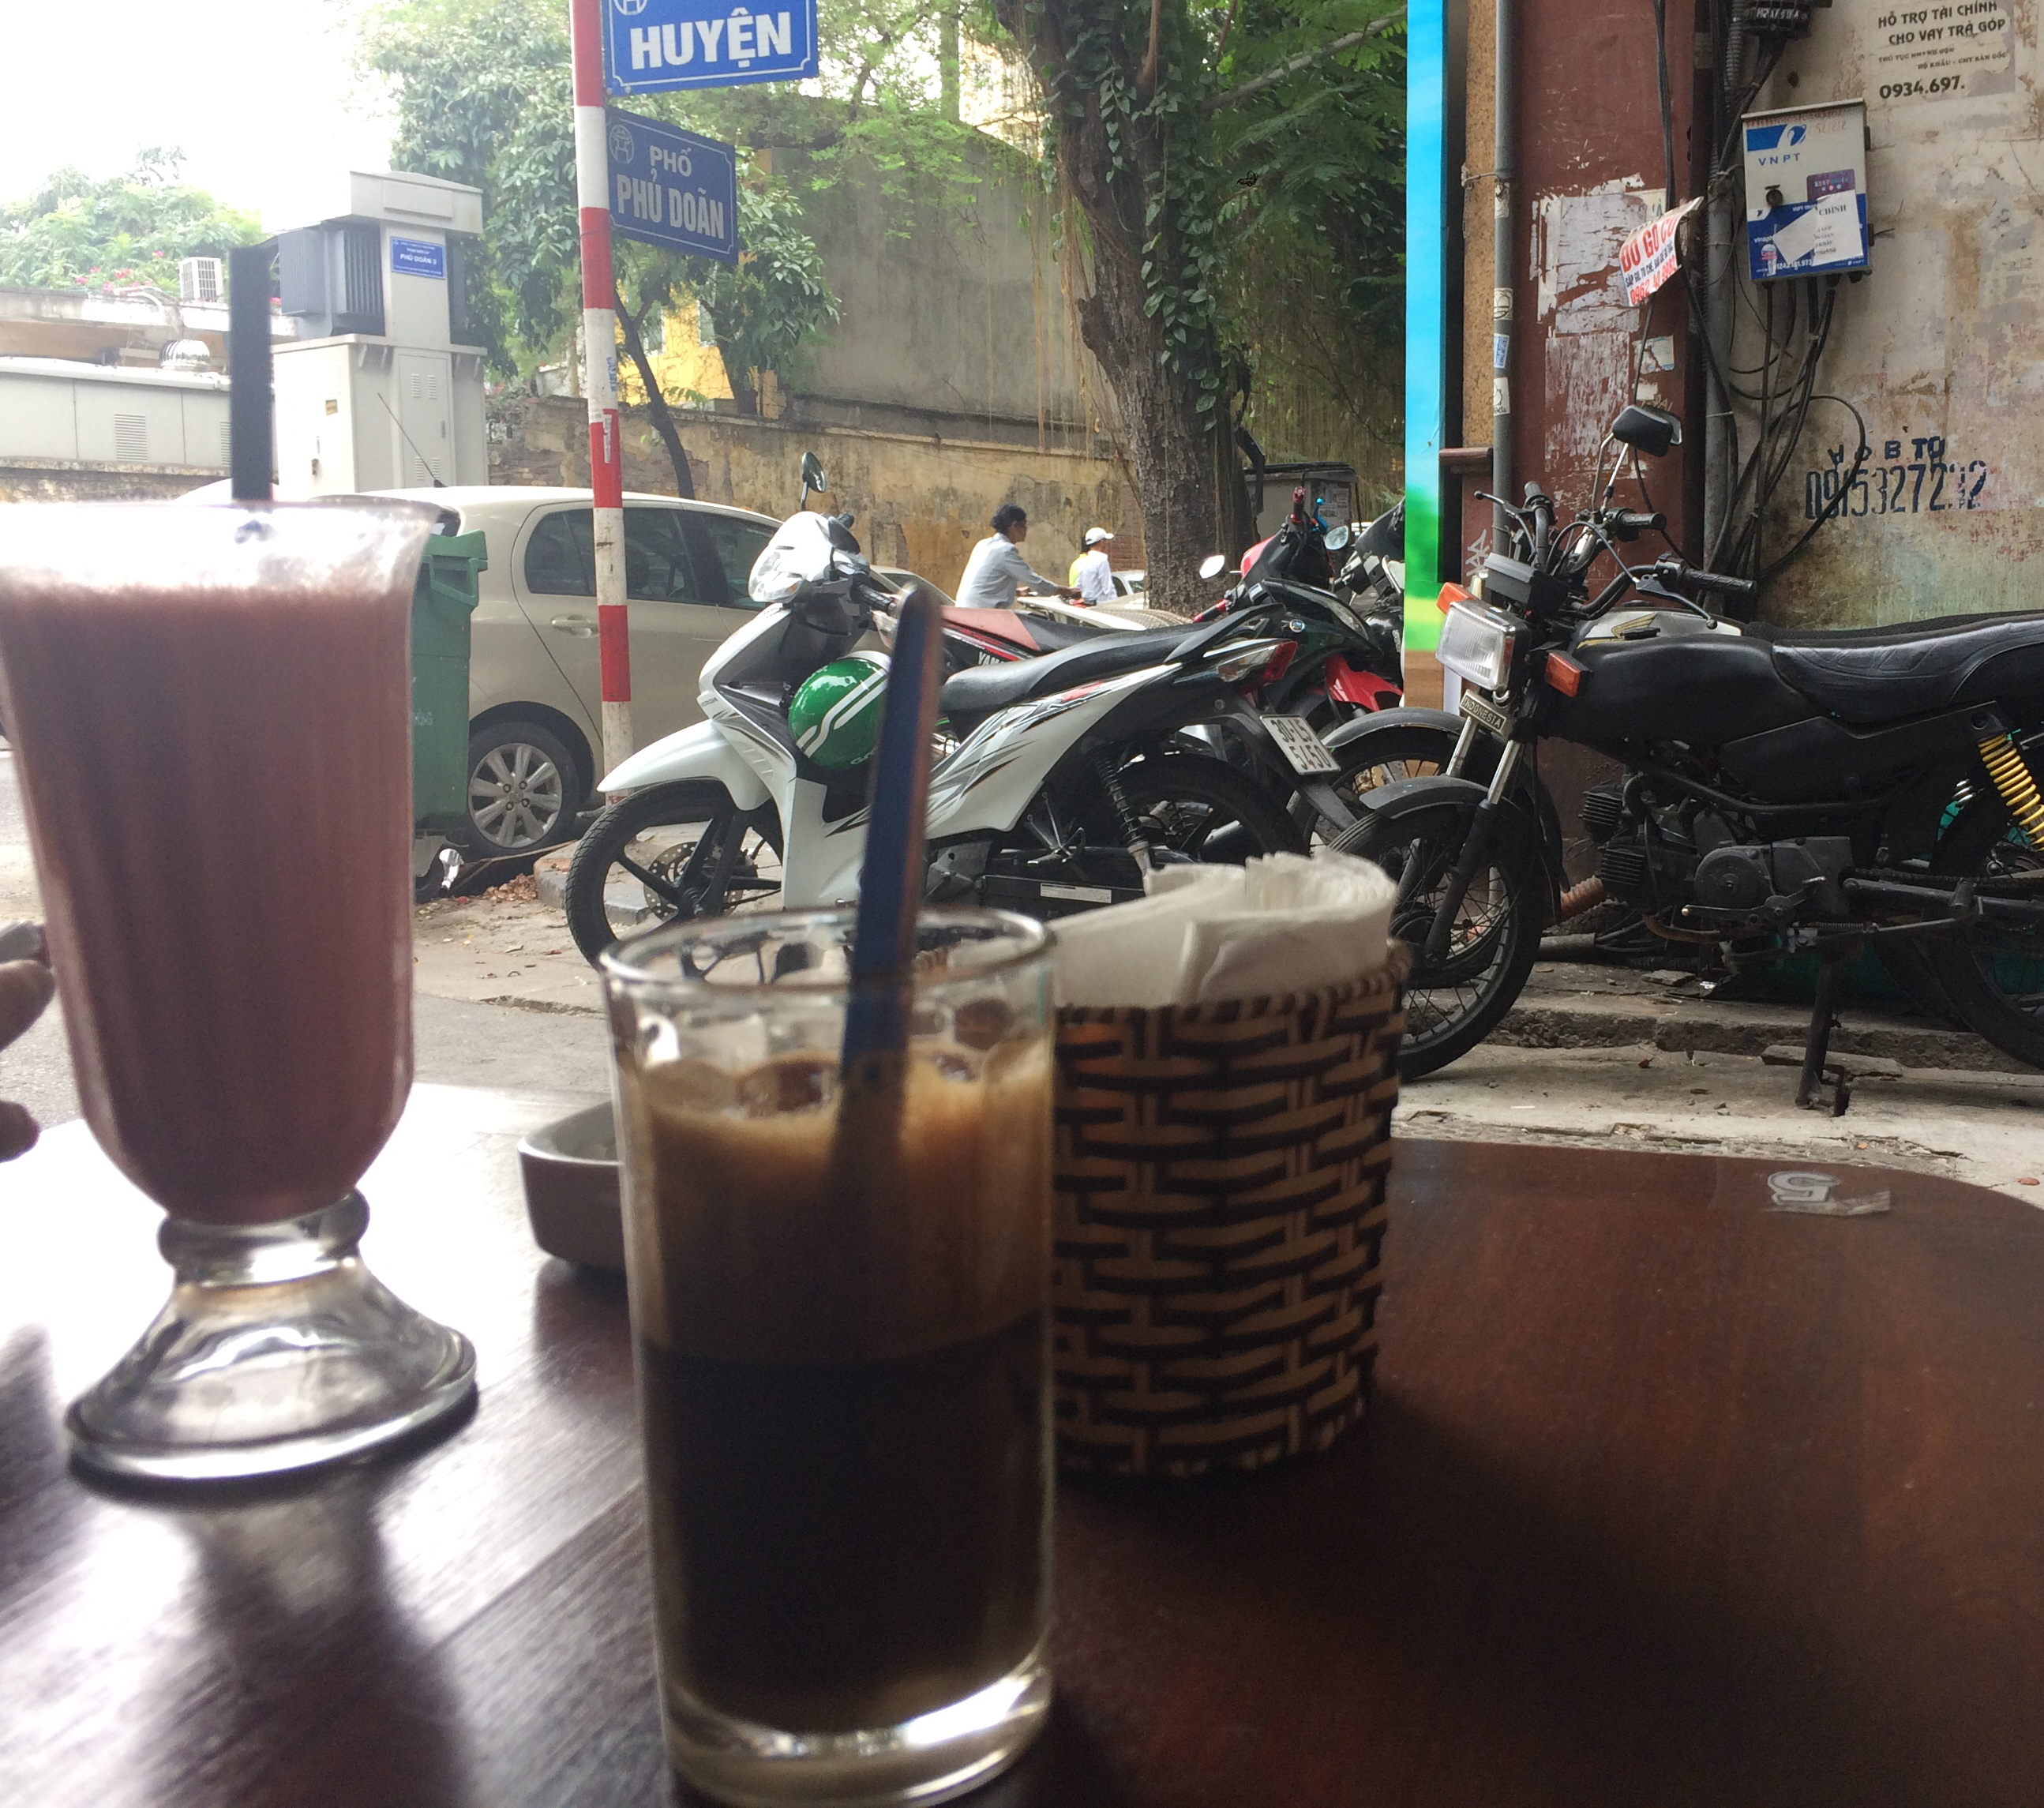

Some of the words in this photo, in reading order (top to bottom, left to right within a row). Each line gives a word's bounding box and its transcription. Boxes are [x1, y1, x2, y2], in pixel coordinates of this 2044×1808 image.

[1901, 9, 1928, 24] TRỢ
[1932, 6, 1952, 20] TÀI
[1957, 0, 1997, 16] CHÍNH
[630, 7, 792, 69] HUYỆN
[1888, 32, 1915, 46] CHO
[1919, 27, 1944, 40] VAY
[1948, 21, 1974, 36] TRẢ
[1978, 18, 2006, 32] GÓP
[650, 145, 692, 177] PHỐ
[1758, 153, 1800, 166] VNPT
[617, 167, 662, 223] PHỦ
[668, 186, 724, 239] DOÃN
[1462, 697, 1501, 728] INDONESIA
